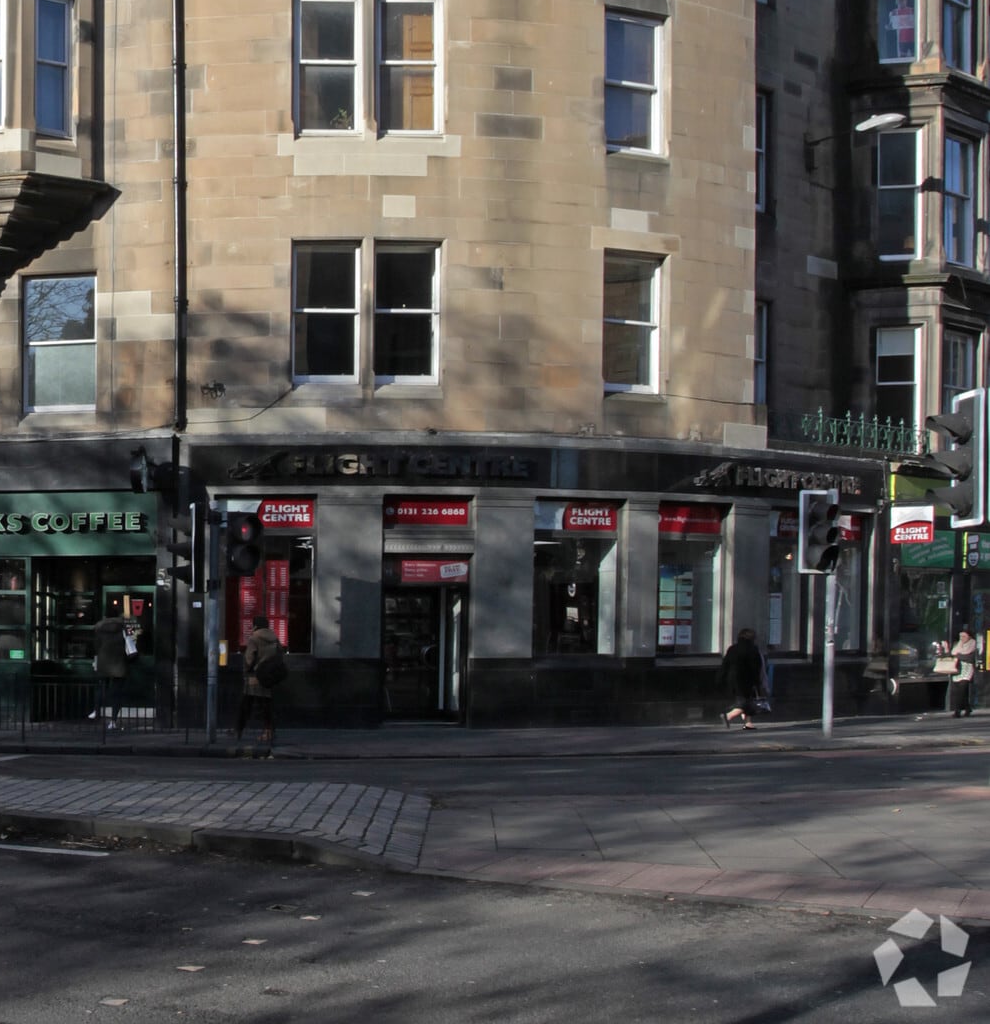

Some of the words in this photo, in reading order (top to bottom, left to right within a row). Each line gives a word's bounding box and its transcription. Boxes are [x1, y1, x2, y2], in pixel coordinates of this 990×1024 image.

[289, 454, 408, 475] FLIGHT
[411, 455, 531, 477] CENTRE
[265, 504, 309, 513] FLIGHT
[397, 507, 418, 515] 0131
[421, 507, 439, 515] 226
[441, 507, 465, 516] 6868
[571, 507, 609, 516] FLIGHT
[30, 511, 141, 532] COFFEE
[262, 513, 310, 522] CENTRE
[569, 516, 612, 526] CENTRE
[895, 526, 928, 534] FLIGHT
[894, 533, 929, 541] CENTRE
